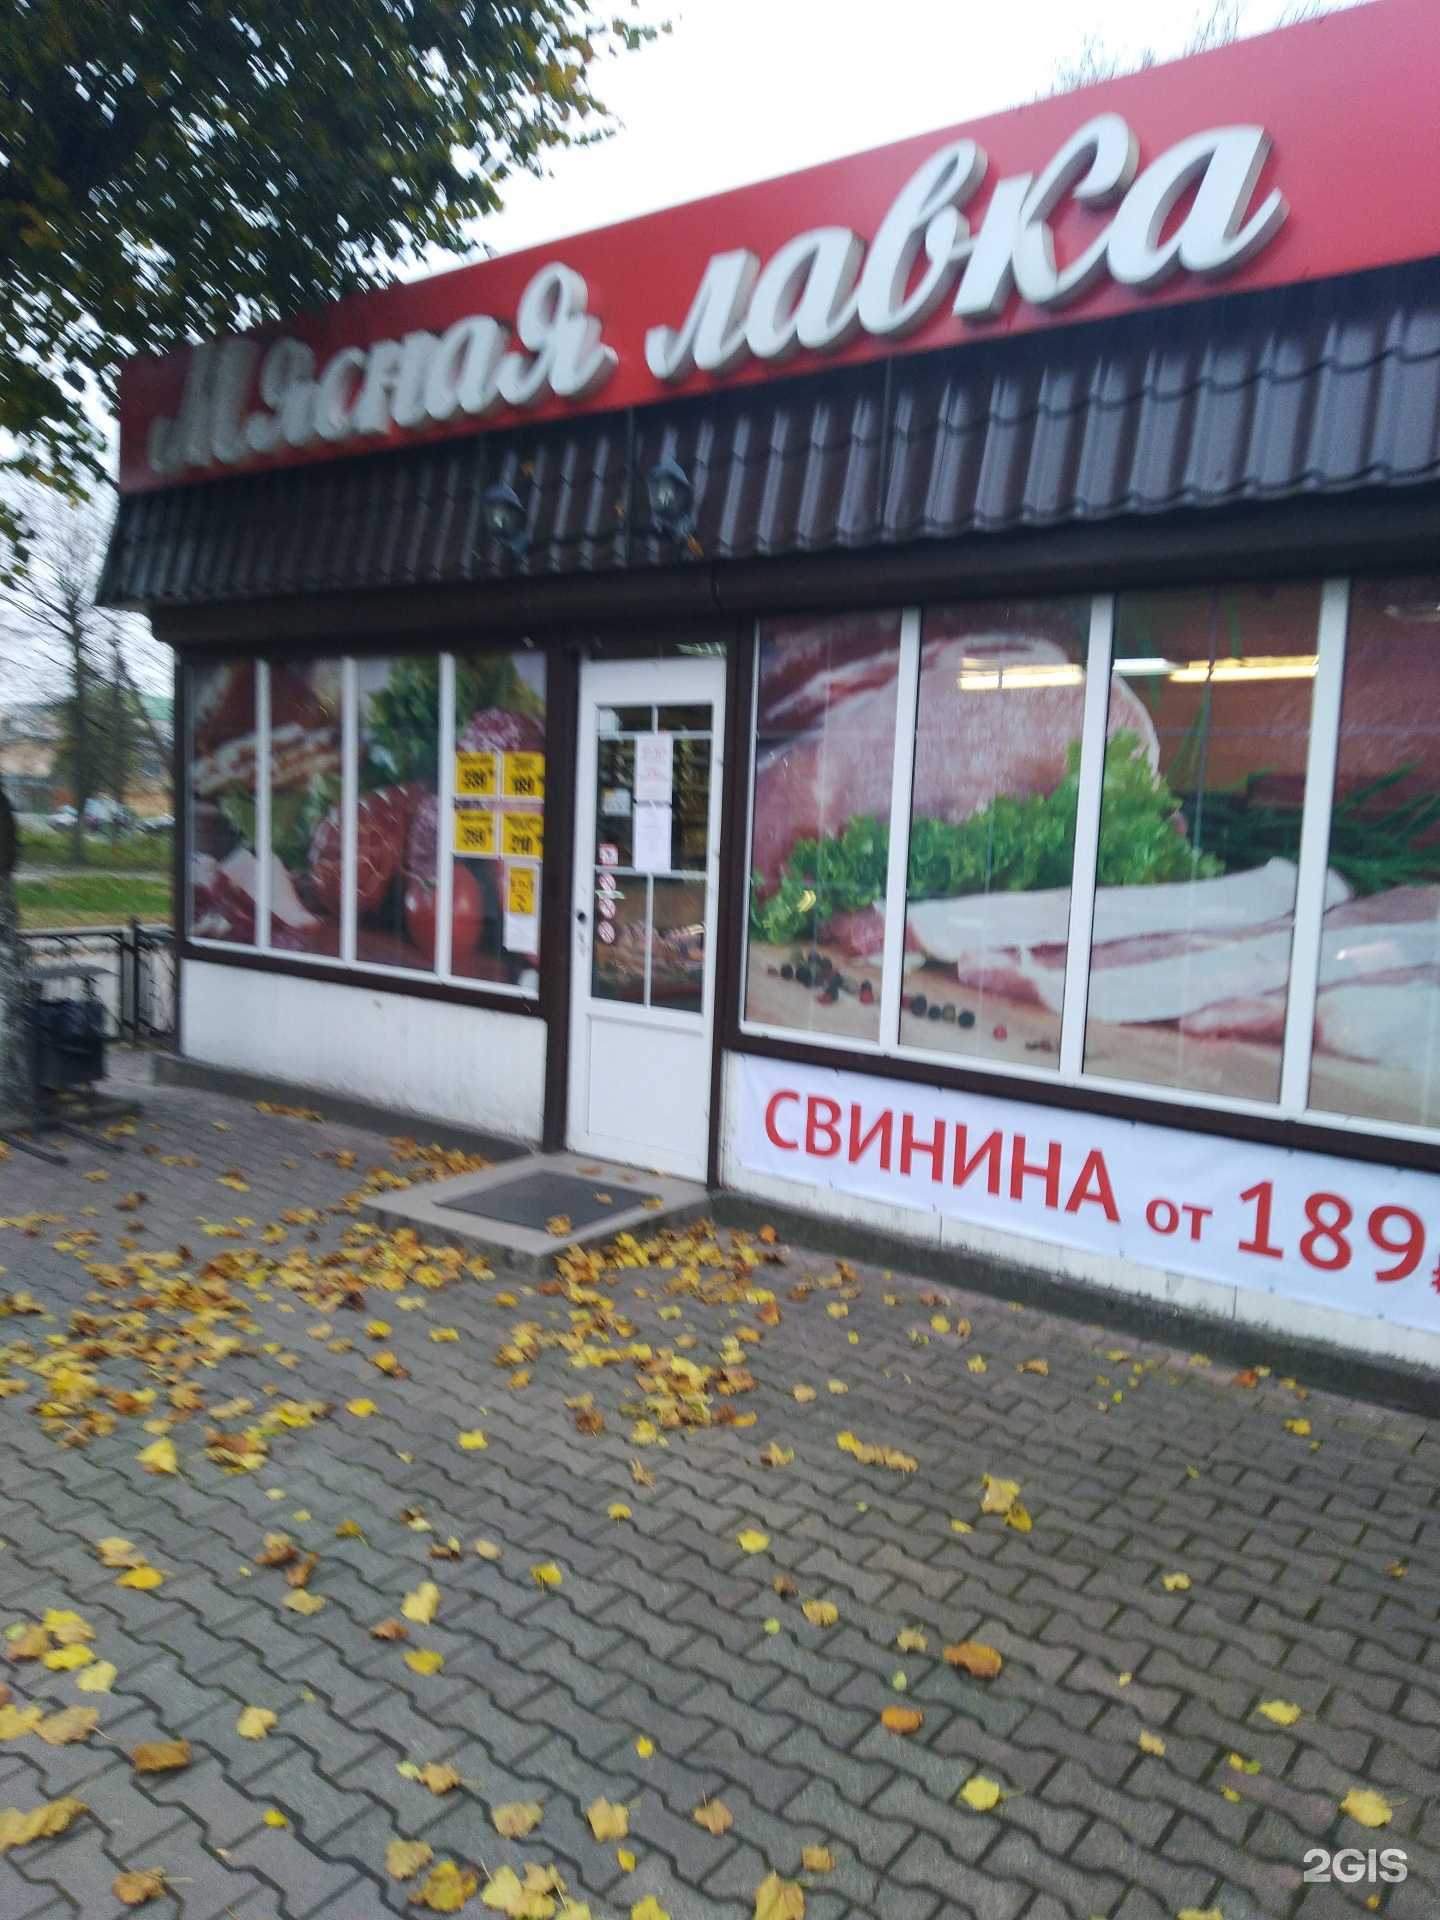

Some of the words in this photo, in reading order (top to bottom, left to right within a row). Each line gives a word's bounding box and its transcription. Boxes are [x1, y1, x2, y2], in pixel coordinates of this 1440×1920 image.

[644, 111, 1289, 380] лавка
[763, 1088, 1121, 1224] СВИНИНА
[1145, 1197, 1213, 1242] от
[1237, 1179, 1440, 1295] 189
